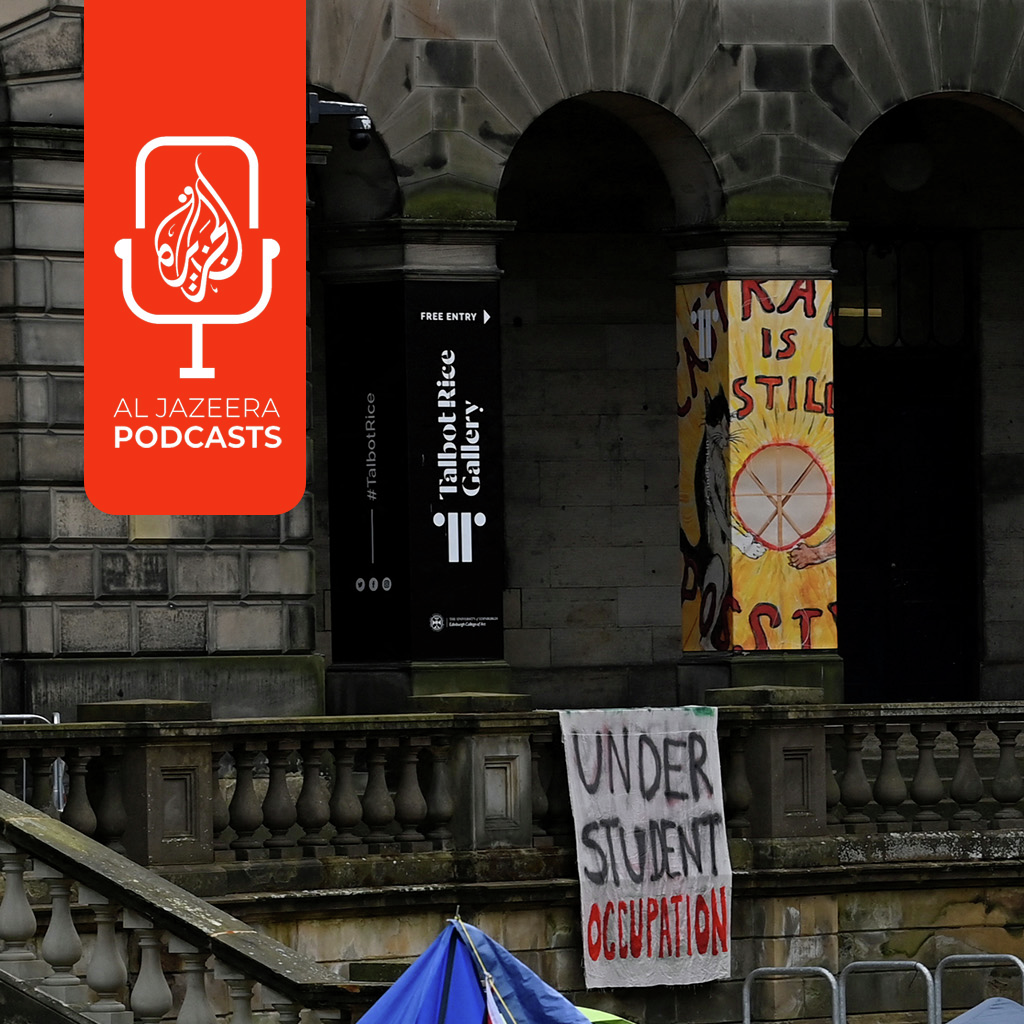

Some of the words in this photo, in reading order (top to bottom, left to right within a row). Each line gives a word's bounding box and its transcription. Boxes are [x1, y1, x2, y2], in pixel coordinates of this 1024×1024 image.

[420, 311, 444, 321] FREE
[446, 312, 477, 321] ENTRY
[761, 327, 798, 361] IS
[436, 349, 456, 408] Rice
[364, 392, 377, 501] #TalbotRice
[437, 411, 458, 500] Talbot
[460, 399, 484, 497] Gallery
[572, 726, 713, 802] UNDER
[581, 812, 722, 887] STUDENT
[587, 885, 728, 962] OCCUPATION
